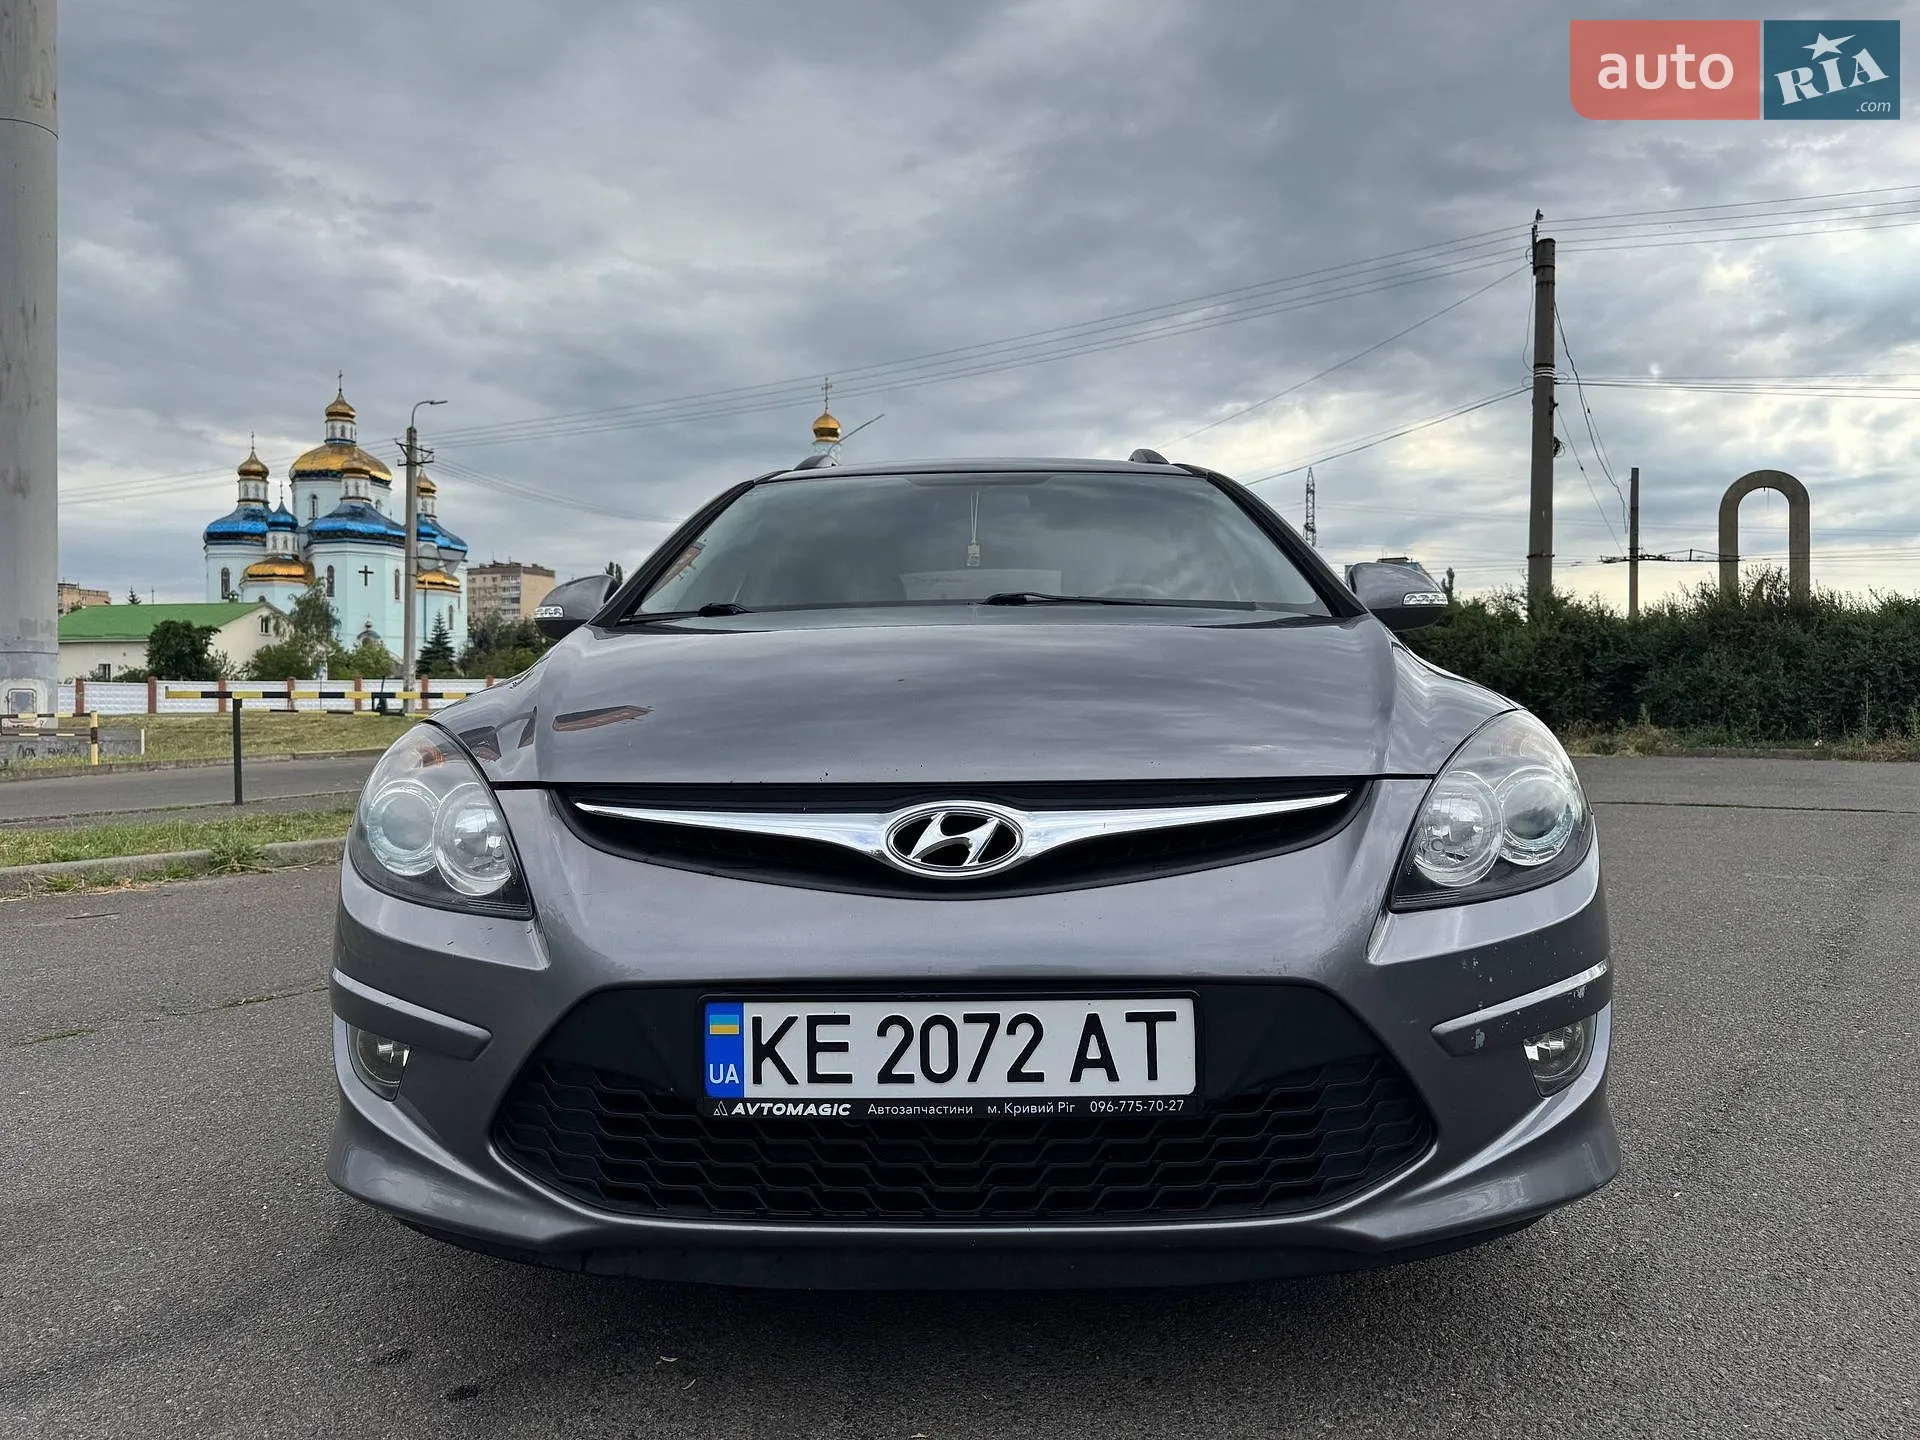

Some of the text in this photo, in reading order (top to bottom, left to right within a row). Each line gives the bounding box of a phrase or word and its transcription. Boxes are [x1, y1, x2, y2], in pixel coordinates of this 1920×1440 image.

[751, 1010, 1177, 1085] KE 2072 AT
[709, 1064, 739, 1084] UA
[732, 1103, 851, 1116] AVTOMAGIC
[867, 1099, 1184, 1116] Автозапчастини м. Кривий Ріг 096-775-70-27
